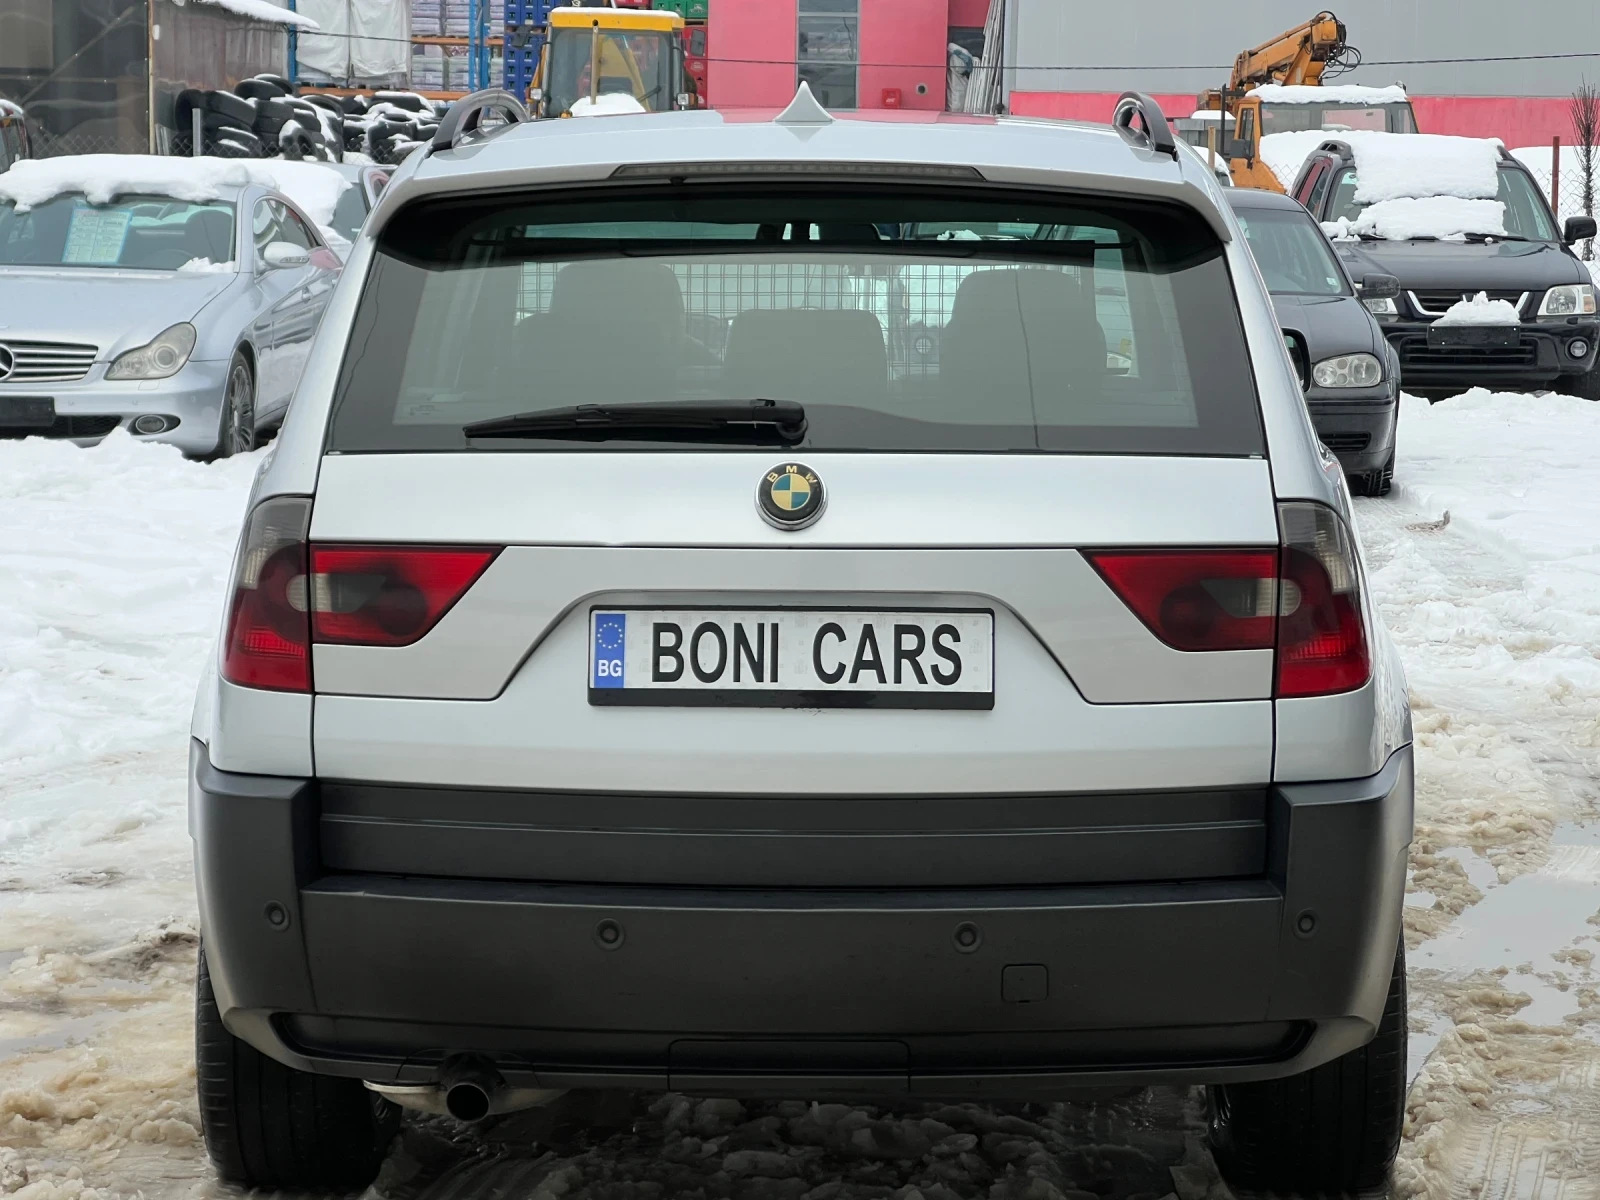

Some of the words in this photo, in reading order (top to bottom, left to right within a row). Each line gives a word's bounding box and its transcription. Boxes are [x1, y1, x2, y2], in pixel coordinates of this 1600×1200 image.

[766, 465, 818, 483] BMW
[652, 621, 779, 683] BONI
[812, 622, 962, 685] CARS
[597, 659, 622, 677] BG
